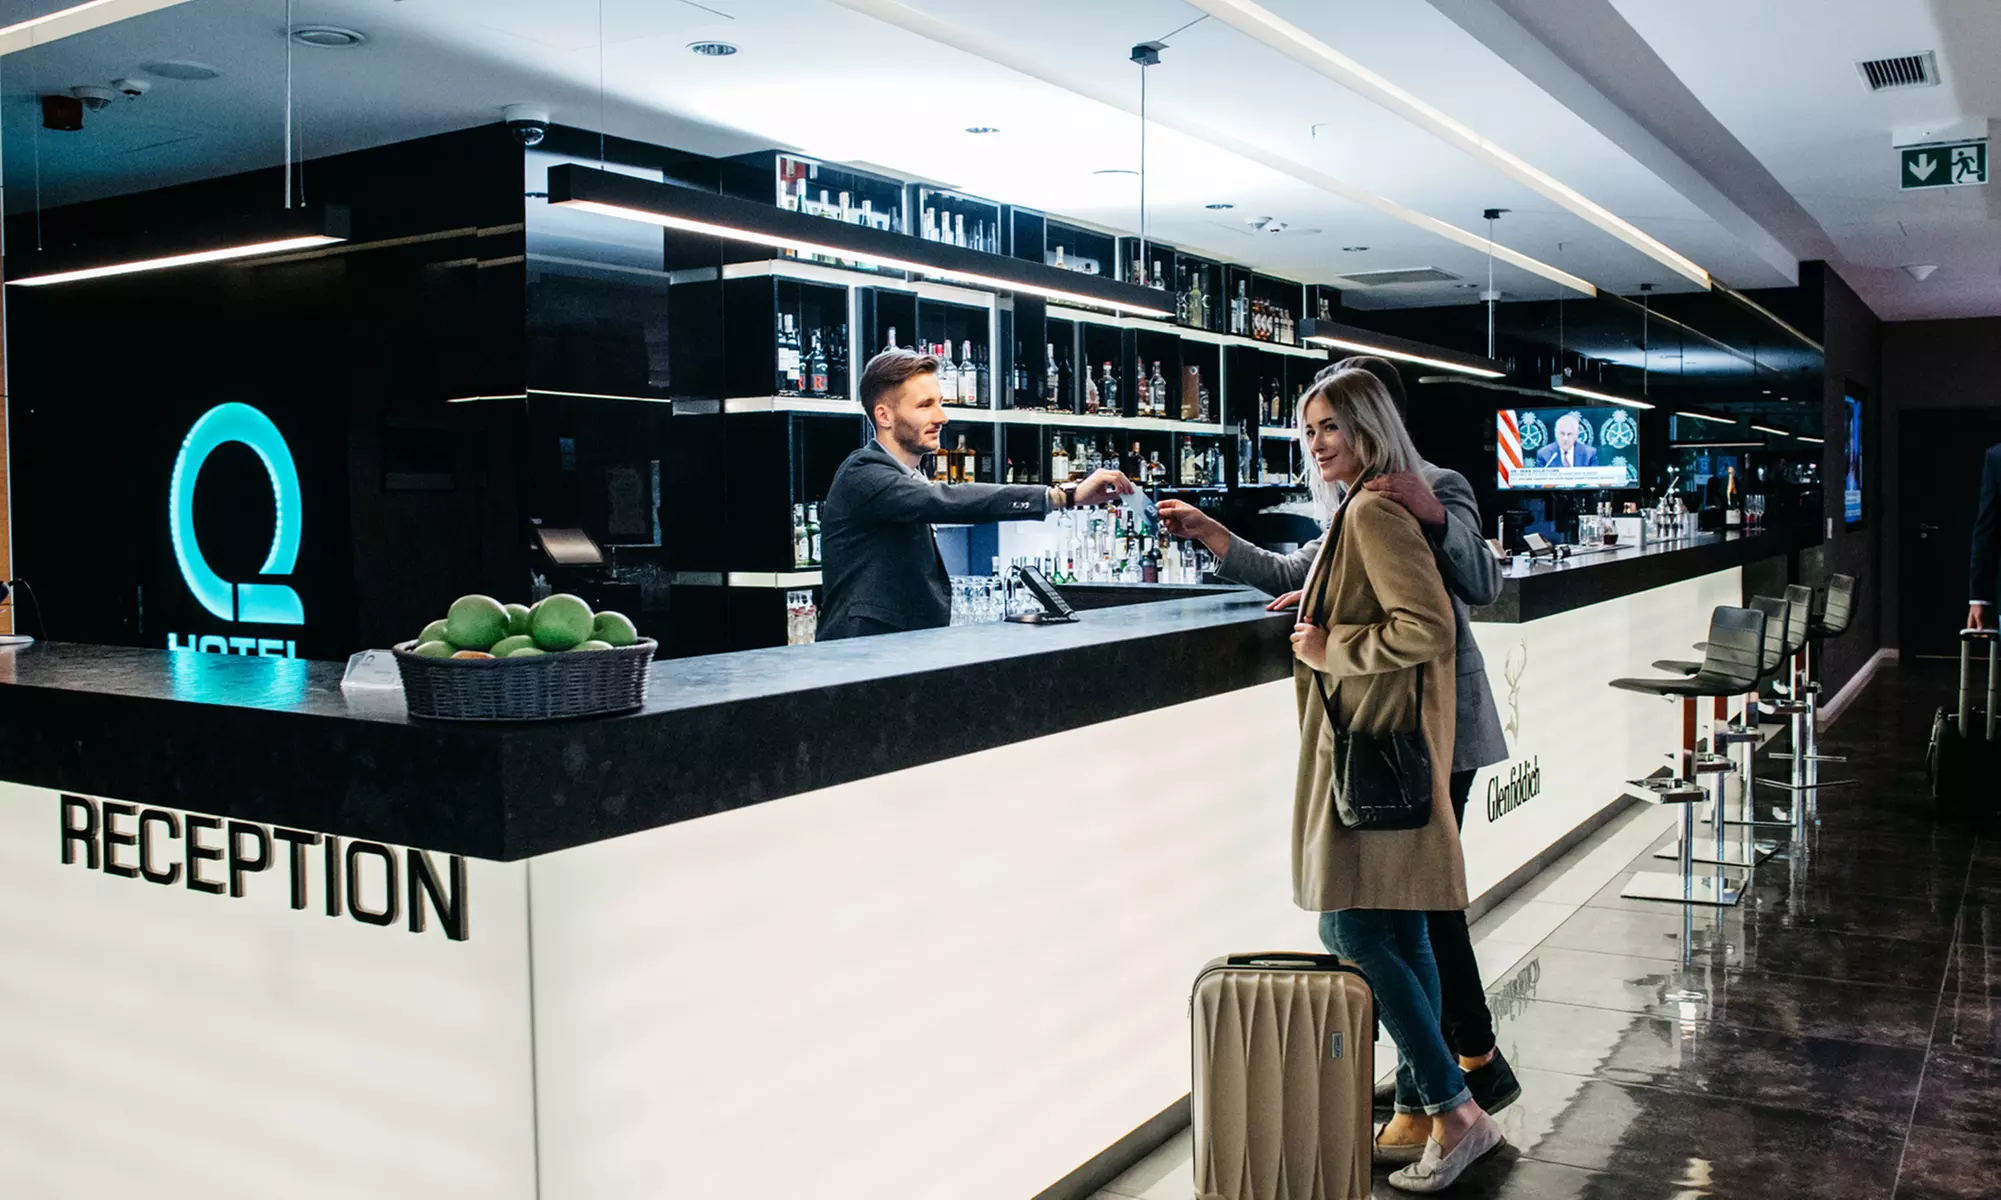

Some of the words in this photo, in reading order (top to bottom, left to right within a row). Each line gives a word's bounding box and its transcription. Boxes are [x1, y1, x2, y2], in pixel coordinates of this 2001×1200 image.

[169, 402, 305, 625] Q
[1487, 755, 1541, 823] Glenfiddich
[60, 793, 469, 942] RECEPTION
